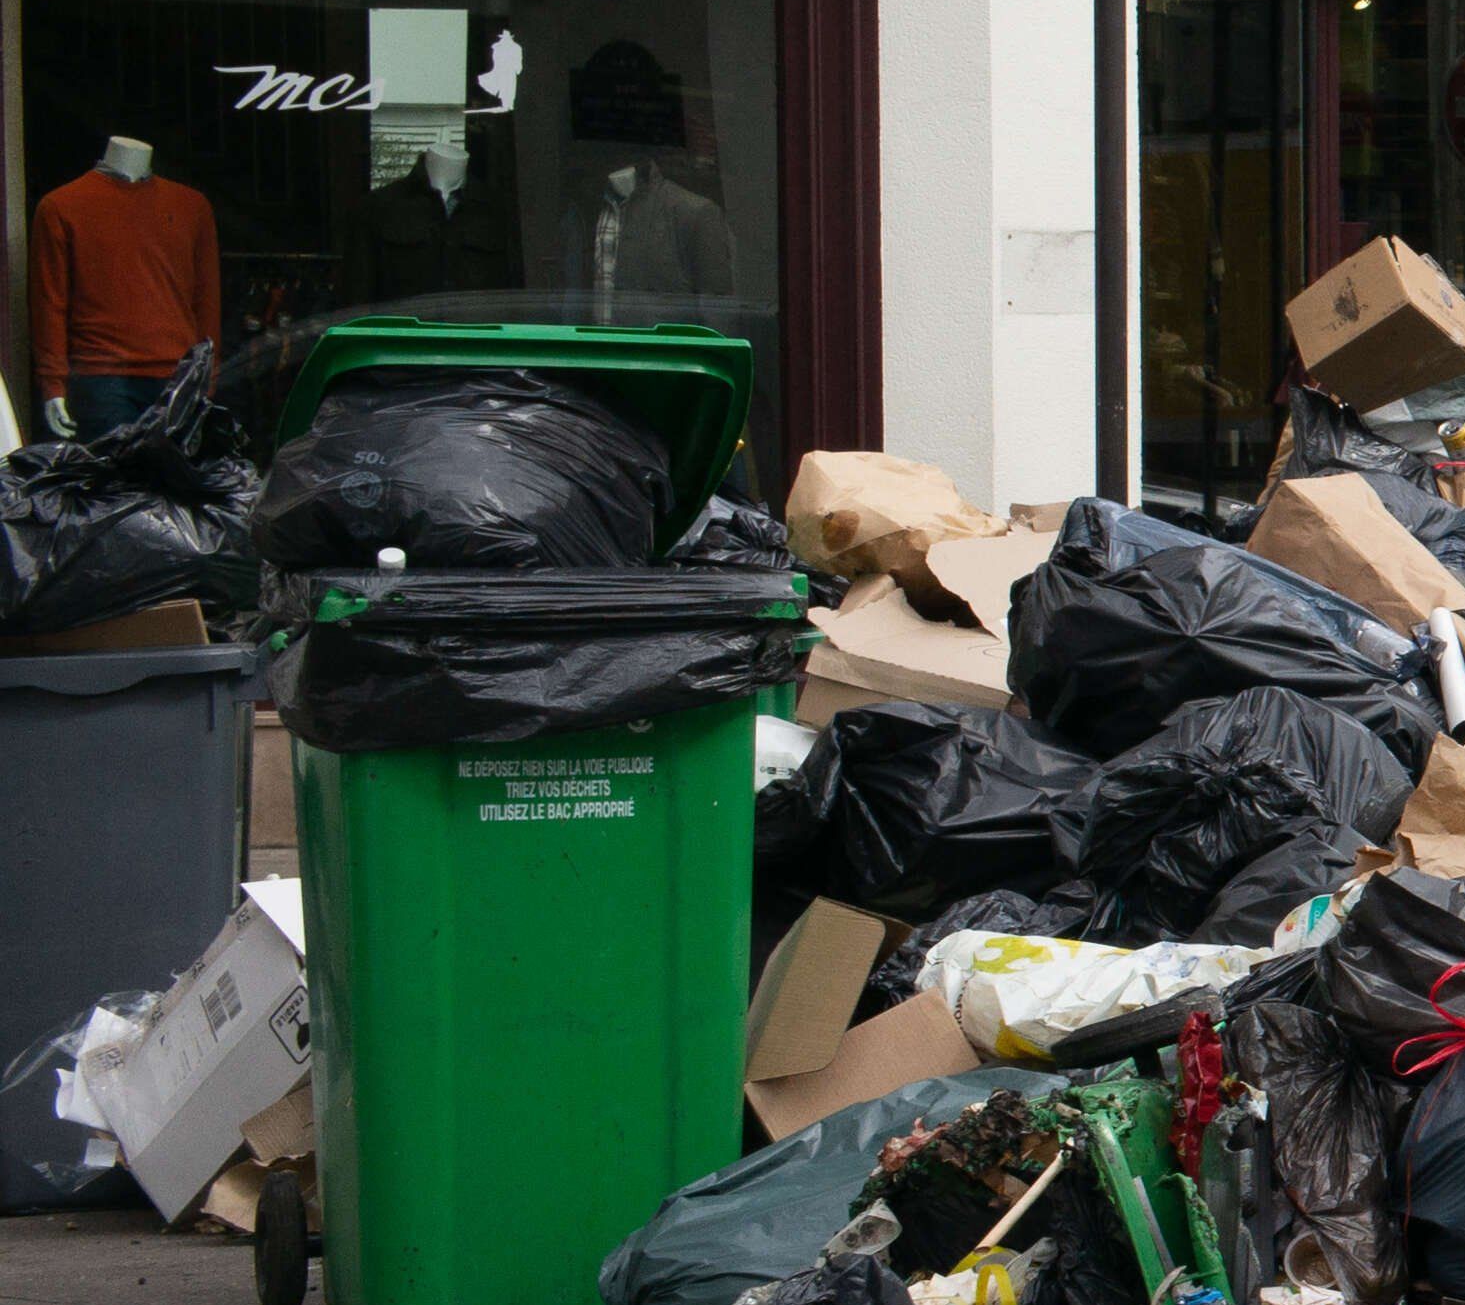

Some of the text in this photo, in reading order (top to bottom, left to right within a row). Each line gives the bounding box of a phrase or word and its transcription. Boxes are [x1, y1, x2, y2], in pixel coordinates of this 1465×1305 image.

[212, 64, 388, 113] mcs
[474, 757, 520, 777] DÉPOSEZ
[522, 760, 545, 777] RIEN
[547, 759, 566, 776] SUR
[569, 758, 581, 775] LA
[584, 758, 606, 775] VOIE
[608, 757, 654, 773] PUBLIQUE
[505, 776, 612, 798] TRIEZ VOS DÉCHETS
[479, 797, 635, 821] UTILISEZ LE BAC APPROPRIÉ
